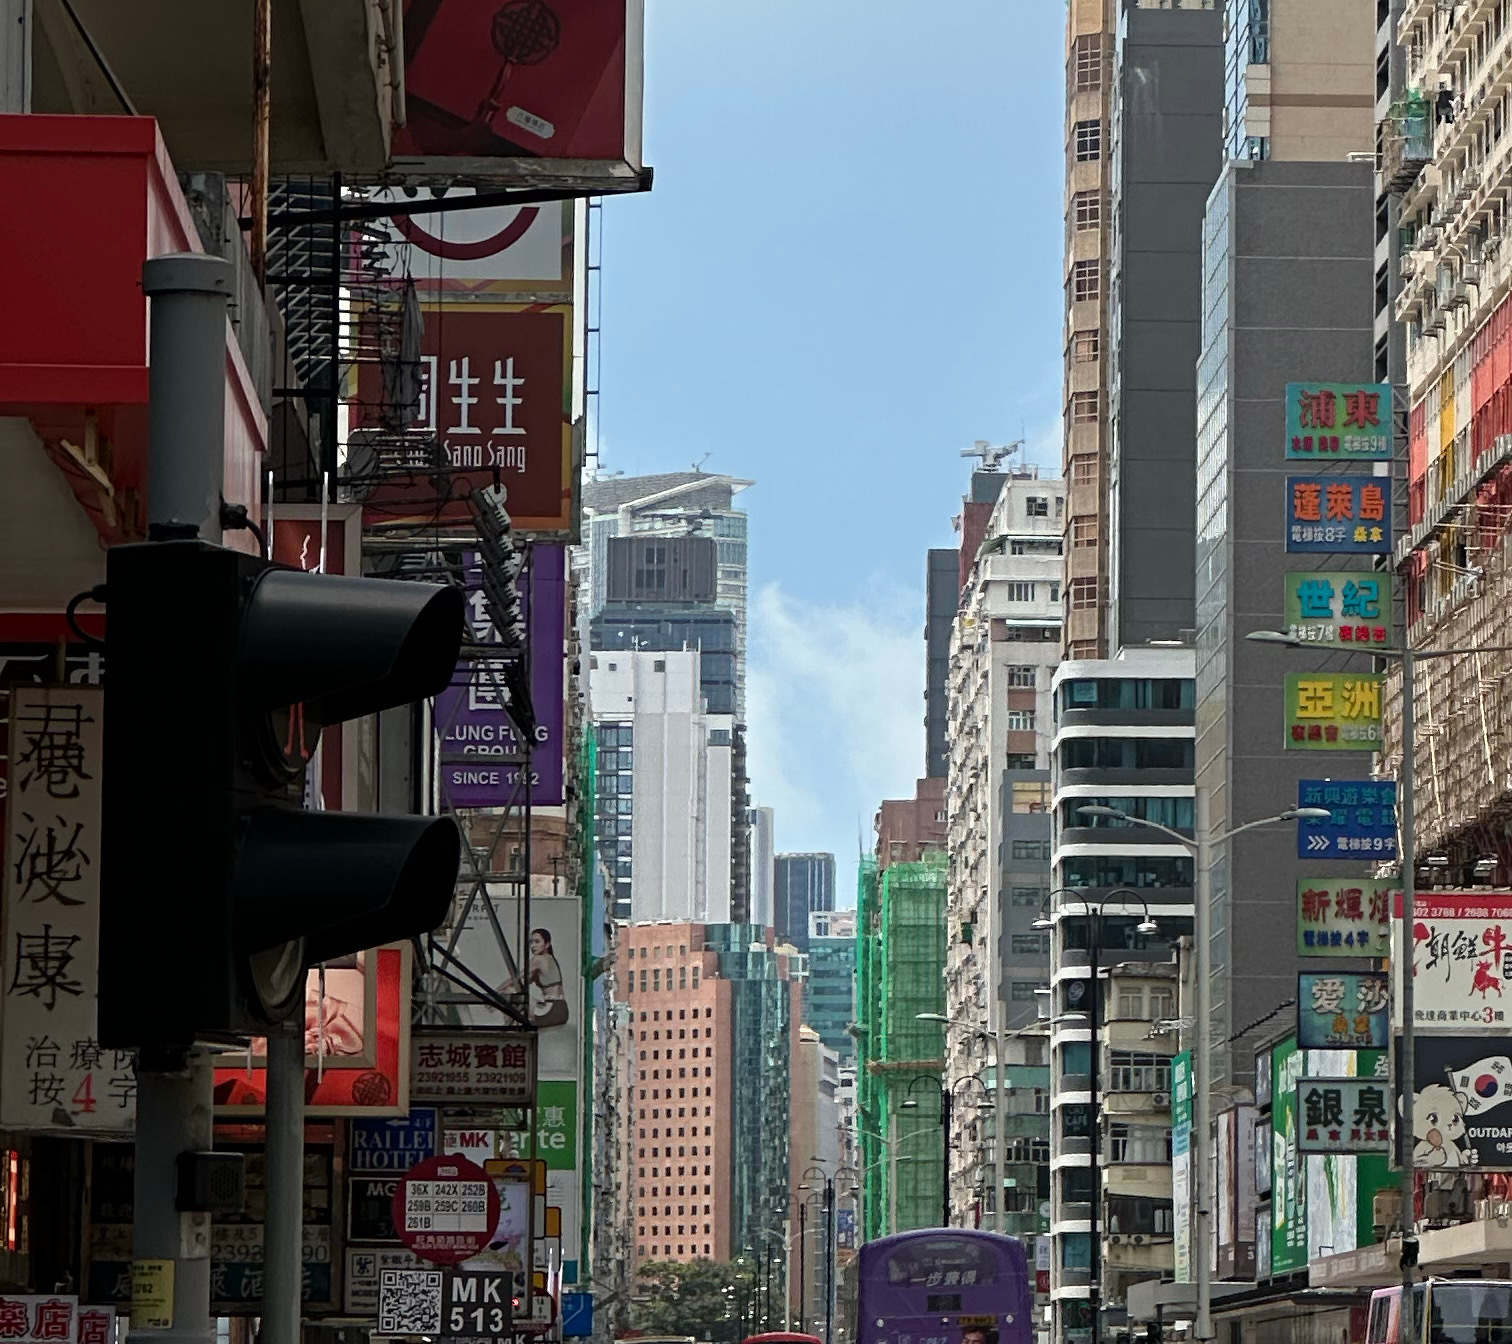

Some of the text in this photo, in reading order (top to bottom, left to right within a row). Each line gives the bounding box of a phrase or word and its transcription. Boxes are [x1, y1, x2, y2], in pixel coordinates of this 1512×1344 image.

[1298, 389, 1380, 428] 浦東
[1294, 482, 1385, 523] 蓬萊島
[1297, 578, 1381, 619] 世紀
[1296, 680, 1380, 720] 亞洲
[498, 725, 549, 742] FUG
[452, 772, 540, 785] SINCE 192
[1337, 837, 1396, 851] 電梯按9字
[418, 1043, 527, 1069] 志城賓館
[29, 1072, 137, 1113] 按4字
[1304, 1086, 1389, 1128] 銀泉
[460, 1132, 489, 1148] MK
[434, 1183, 458, 1195] 242X
[452, 1276, 502, 1303] MK
[450, 1307, 504, 1333] 513
